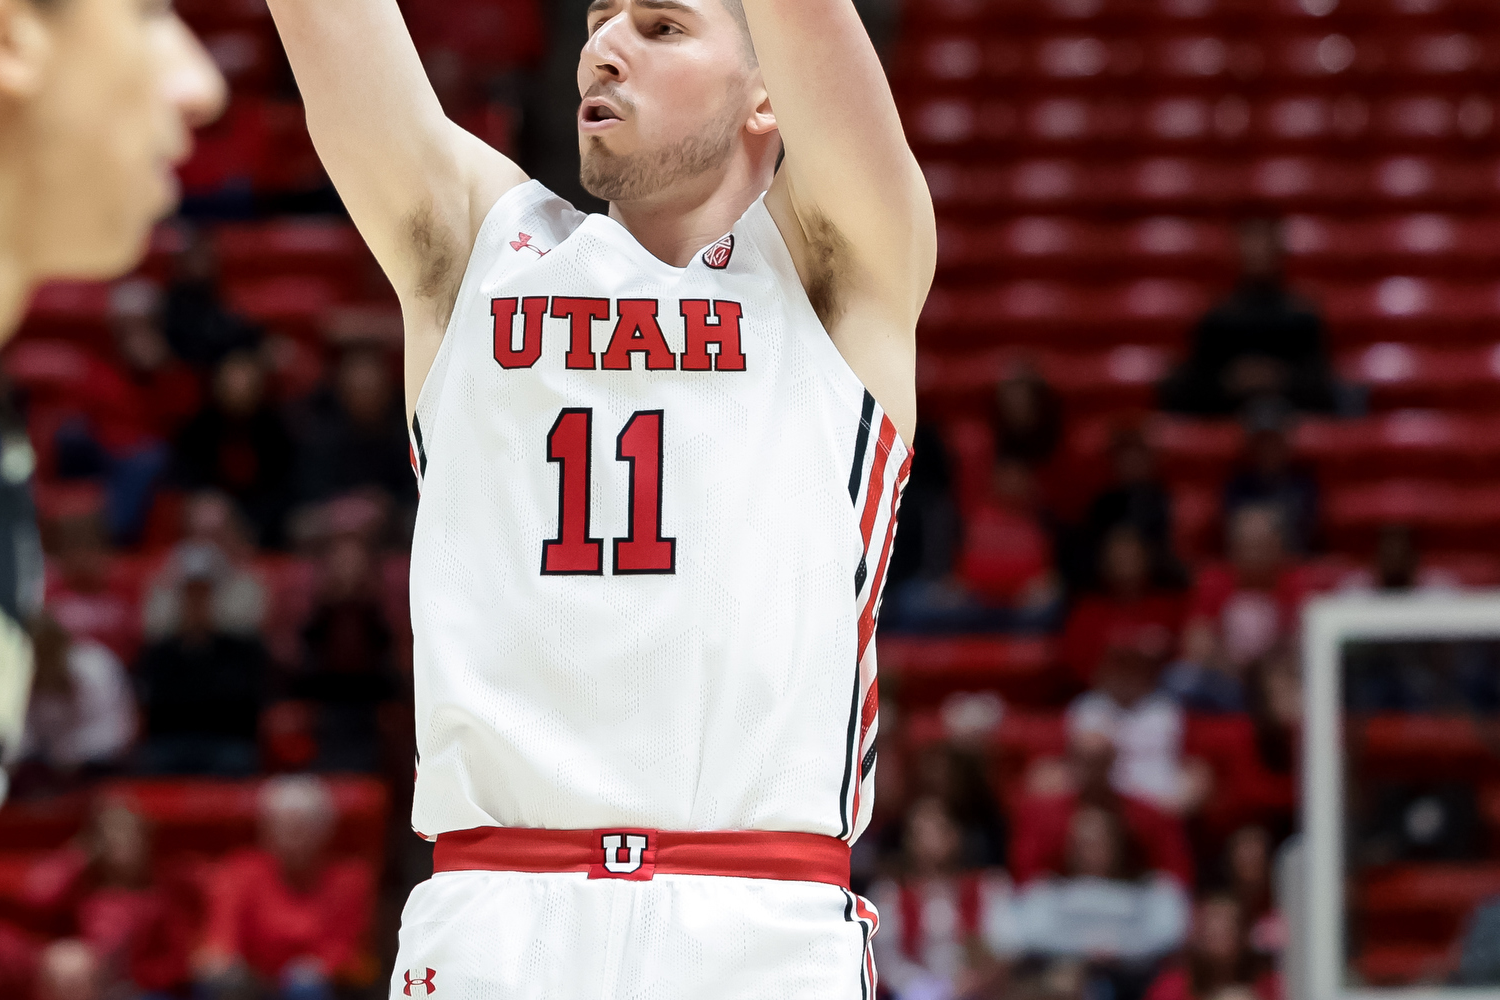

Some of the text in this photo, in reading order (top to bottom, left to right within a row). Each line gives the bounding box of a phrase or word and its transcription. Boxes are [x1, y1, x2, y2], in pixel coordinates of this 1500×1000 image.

[491, 296, 747, 371] UTAH
[540, 407, 676, 576] 11
[601, 833, 648, 873] U
